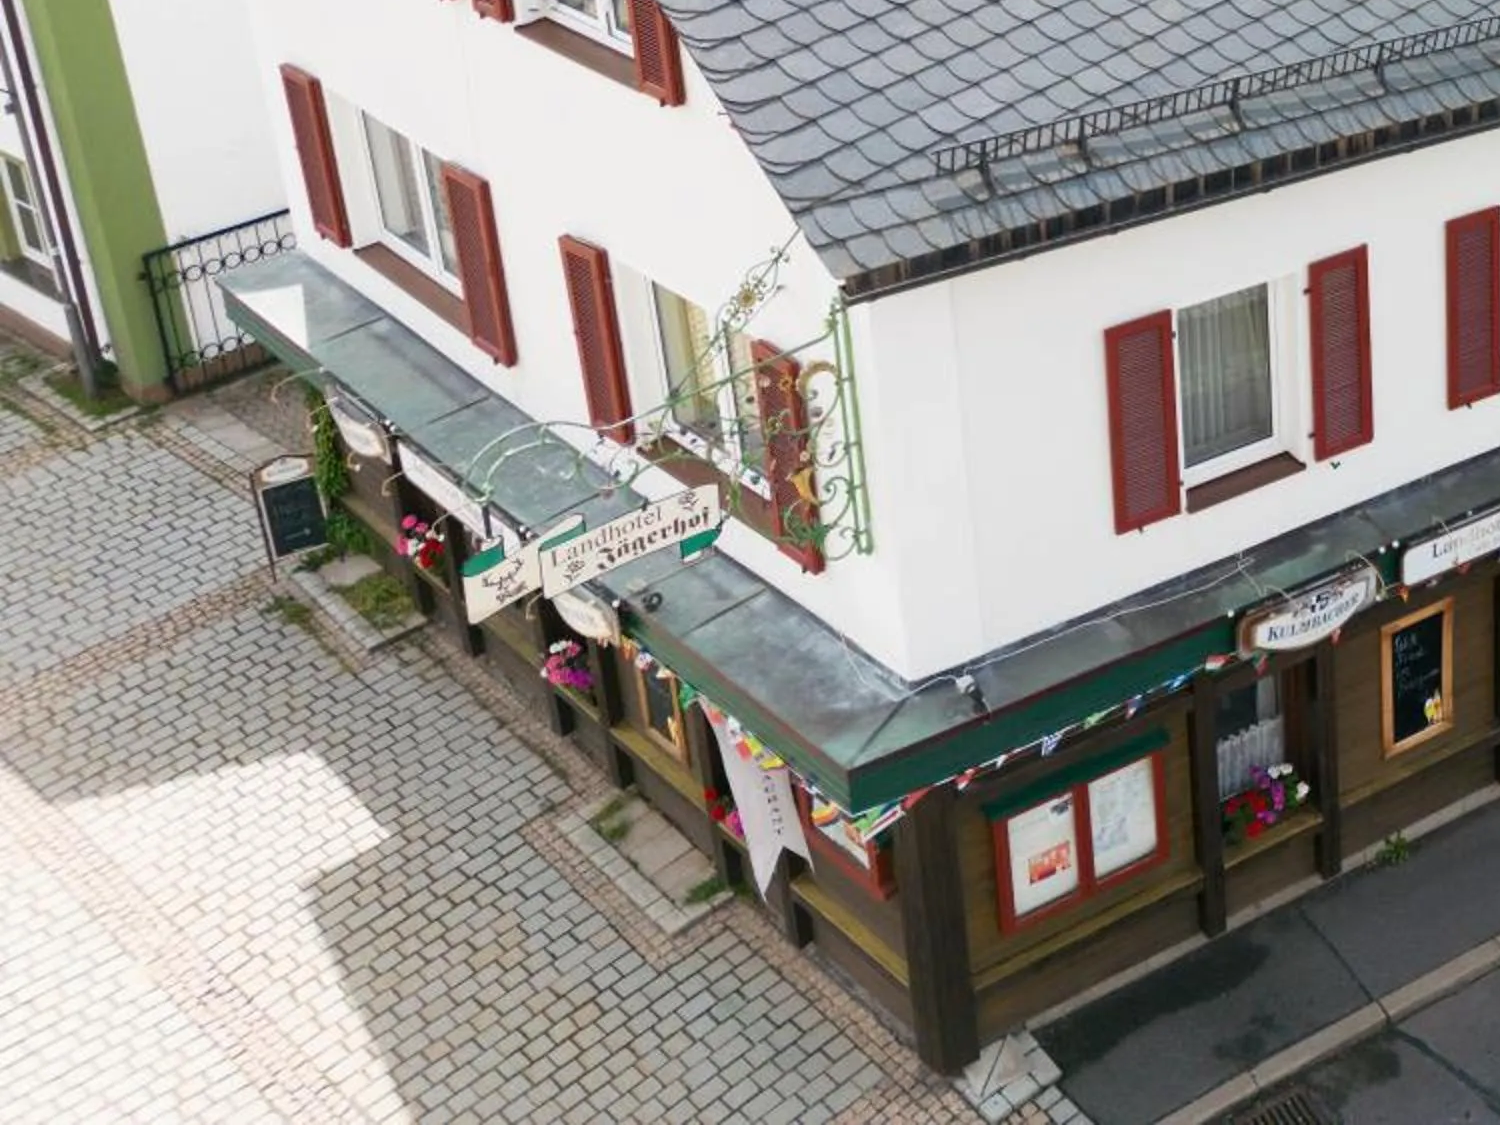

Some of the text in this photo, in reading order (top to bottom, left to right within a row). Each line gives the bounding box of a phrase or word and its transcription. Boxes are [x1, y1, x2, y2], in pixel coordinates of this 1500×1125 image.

[551, 505, 662, 567] Landhotel
[596, 506, 710, 571] Jägerhof
[1267, 592, 1360, 642] KULMBACHER
